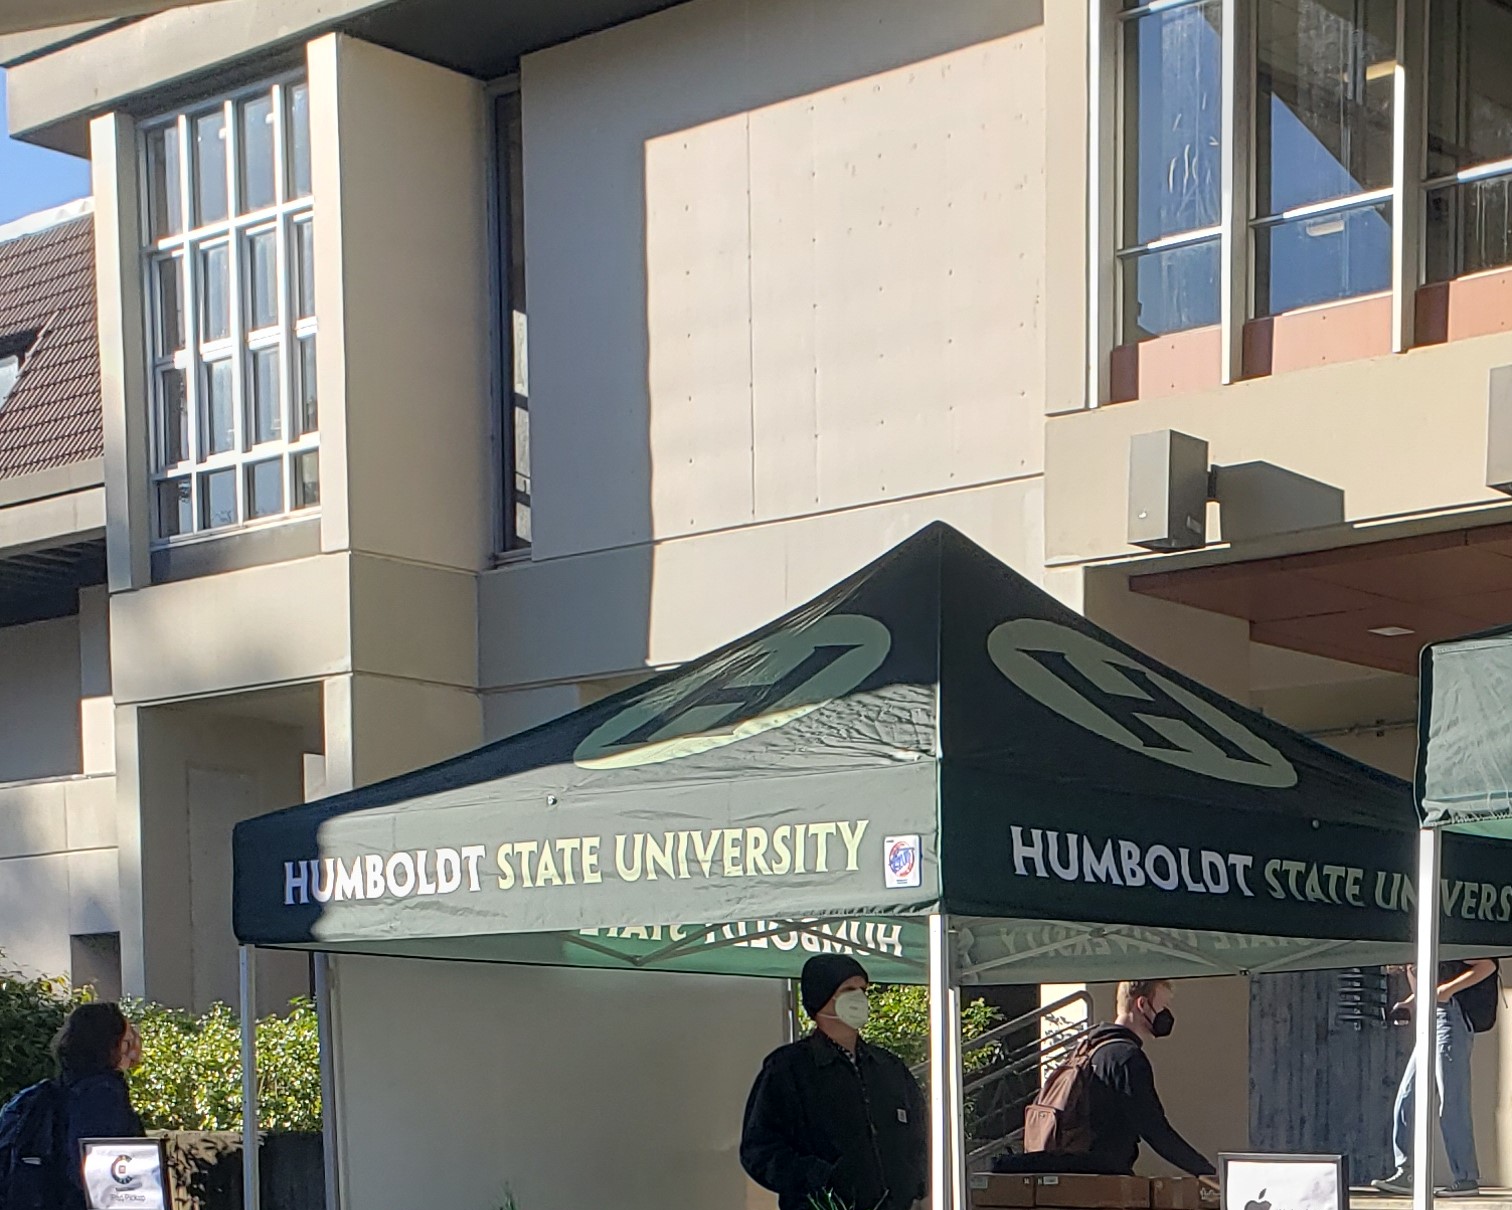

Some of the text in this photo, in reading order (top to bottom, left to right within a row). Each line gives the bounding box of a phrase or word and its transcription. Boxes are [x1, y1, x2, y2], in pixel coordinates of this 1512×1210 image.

[284, 845, 486, 905] HUMBOLDT
[497, 836, 602, 889] STATE
[615, 820, 869, 882] UNIVERSITY
[1010, 825, 1254, 898] HUMBOLDT
[1264, 858, 1364, 908] STATE
